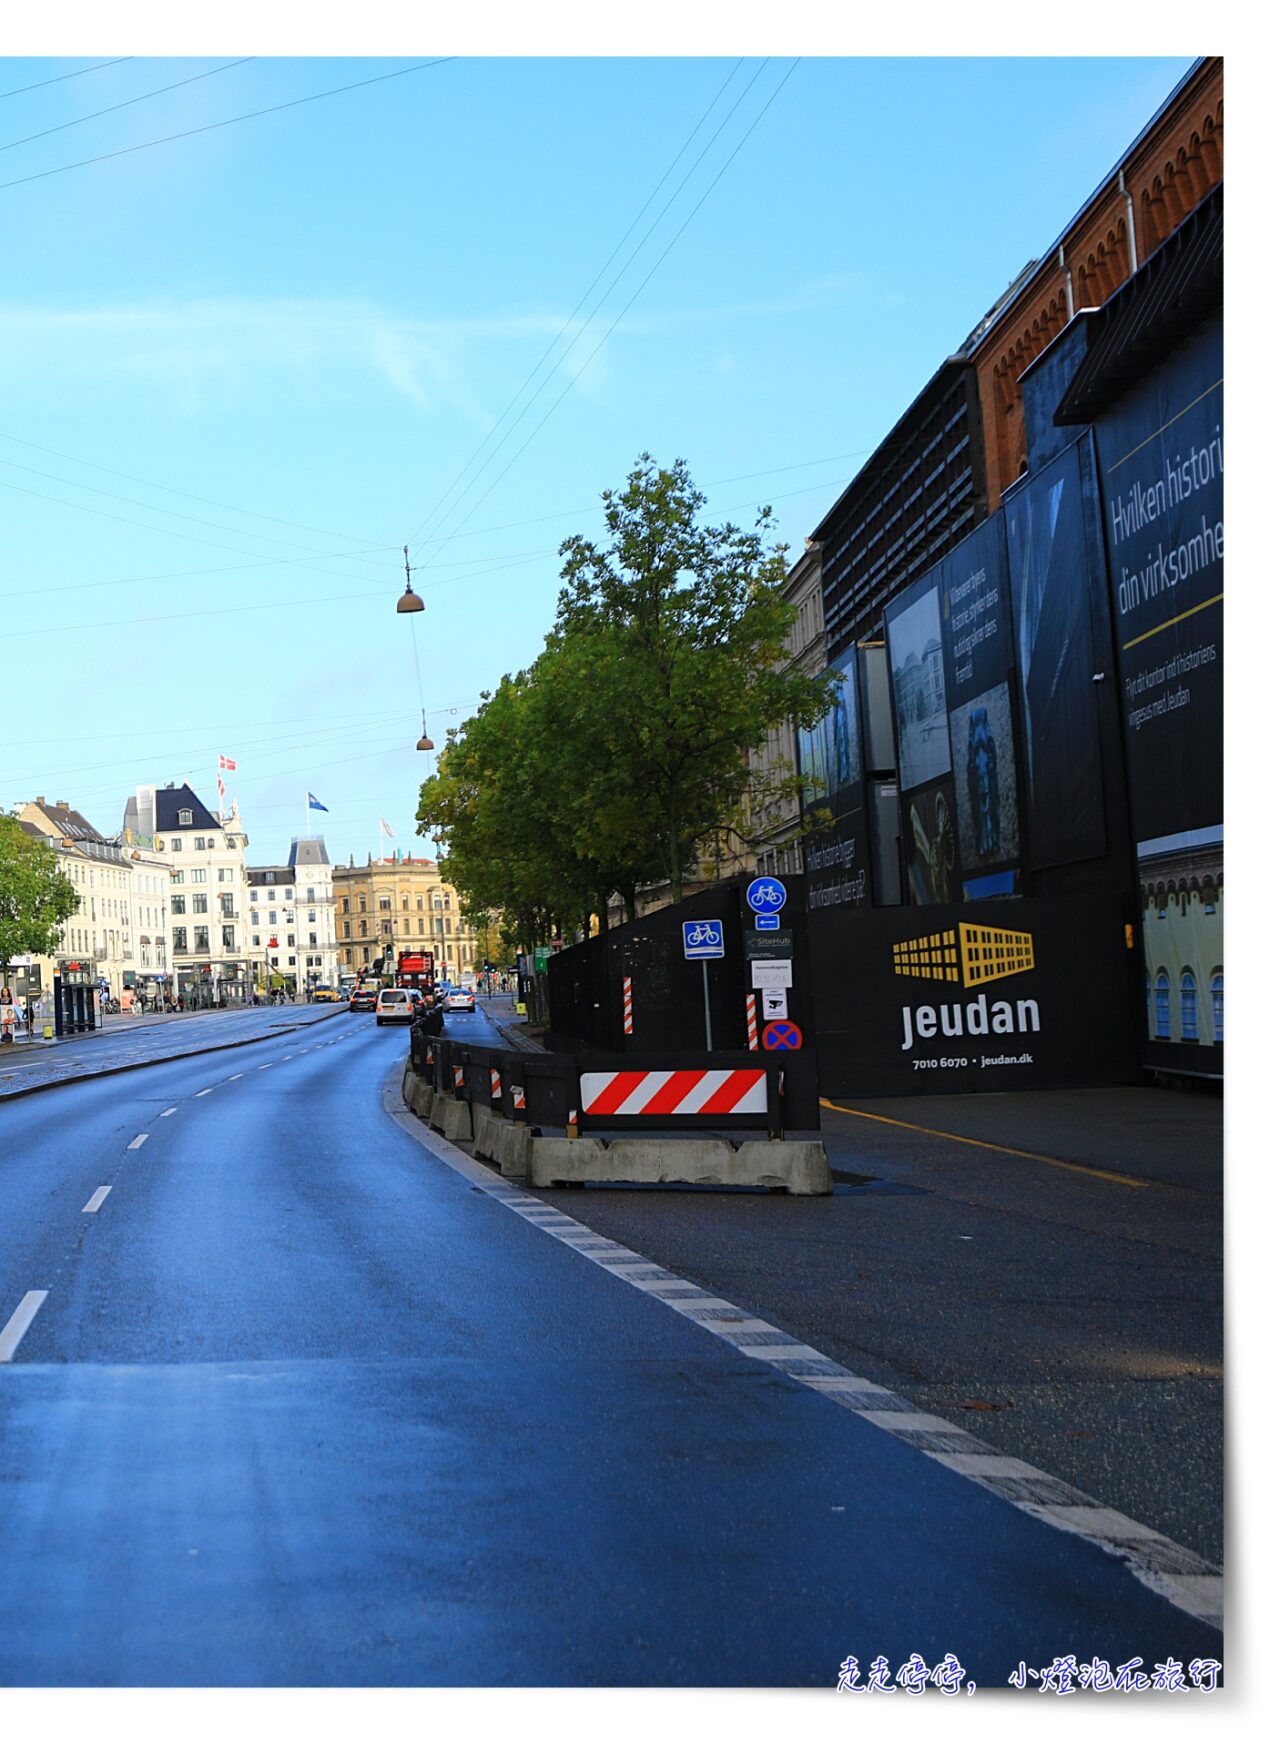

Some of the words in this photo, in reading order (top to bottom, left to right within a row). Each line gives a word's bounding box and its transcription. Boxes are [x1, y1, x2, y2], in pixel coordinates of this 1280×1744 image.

[1111, 480, 1167, 546] Hvilken
[1119, 566, 1140, 614] din
[757, 937, 791, 945] SiteHub
[902, 994, 1040, 1050] jeudan
[912, 1060, 938, 1070] 7010
[940, 1058, 968, 1068] 6070
[981, 1053, 1034, 1068] jeudan.dk
